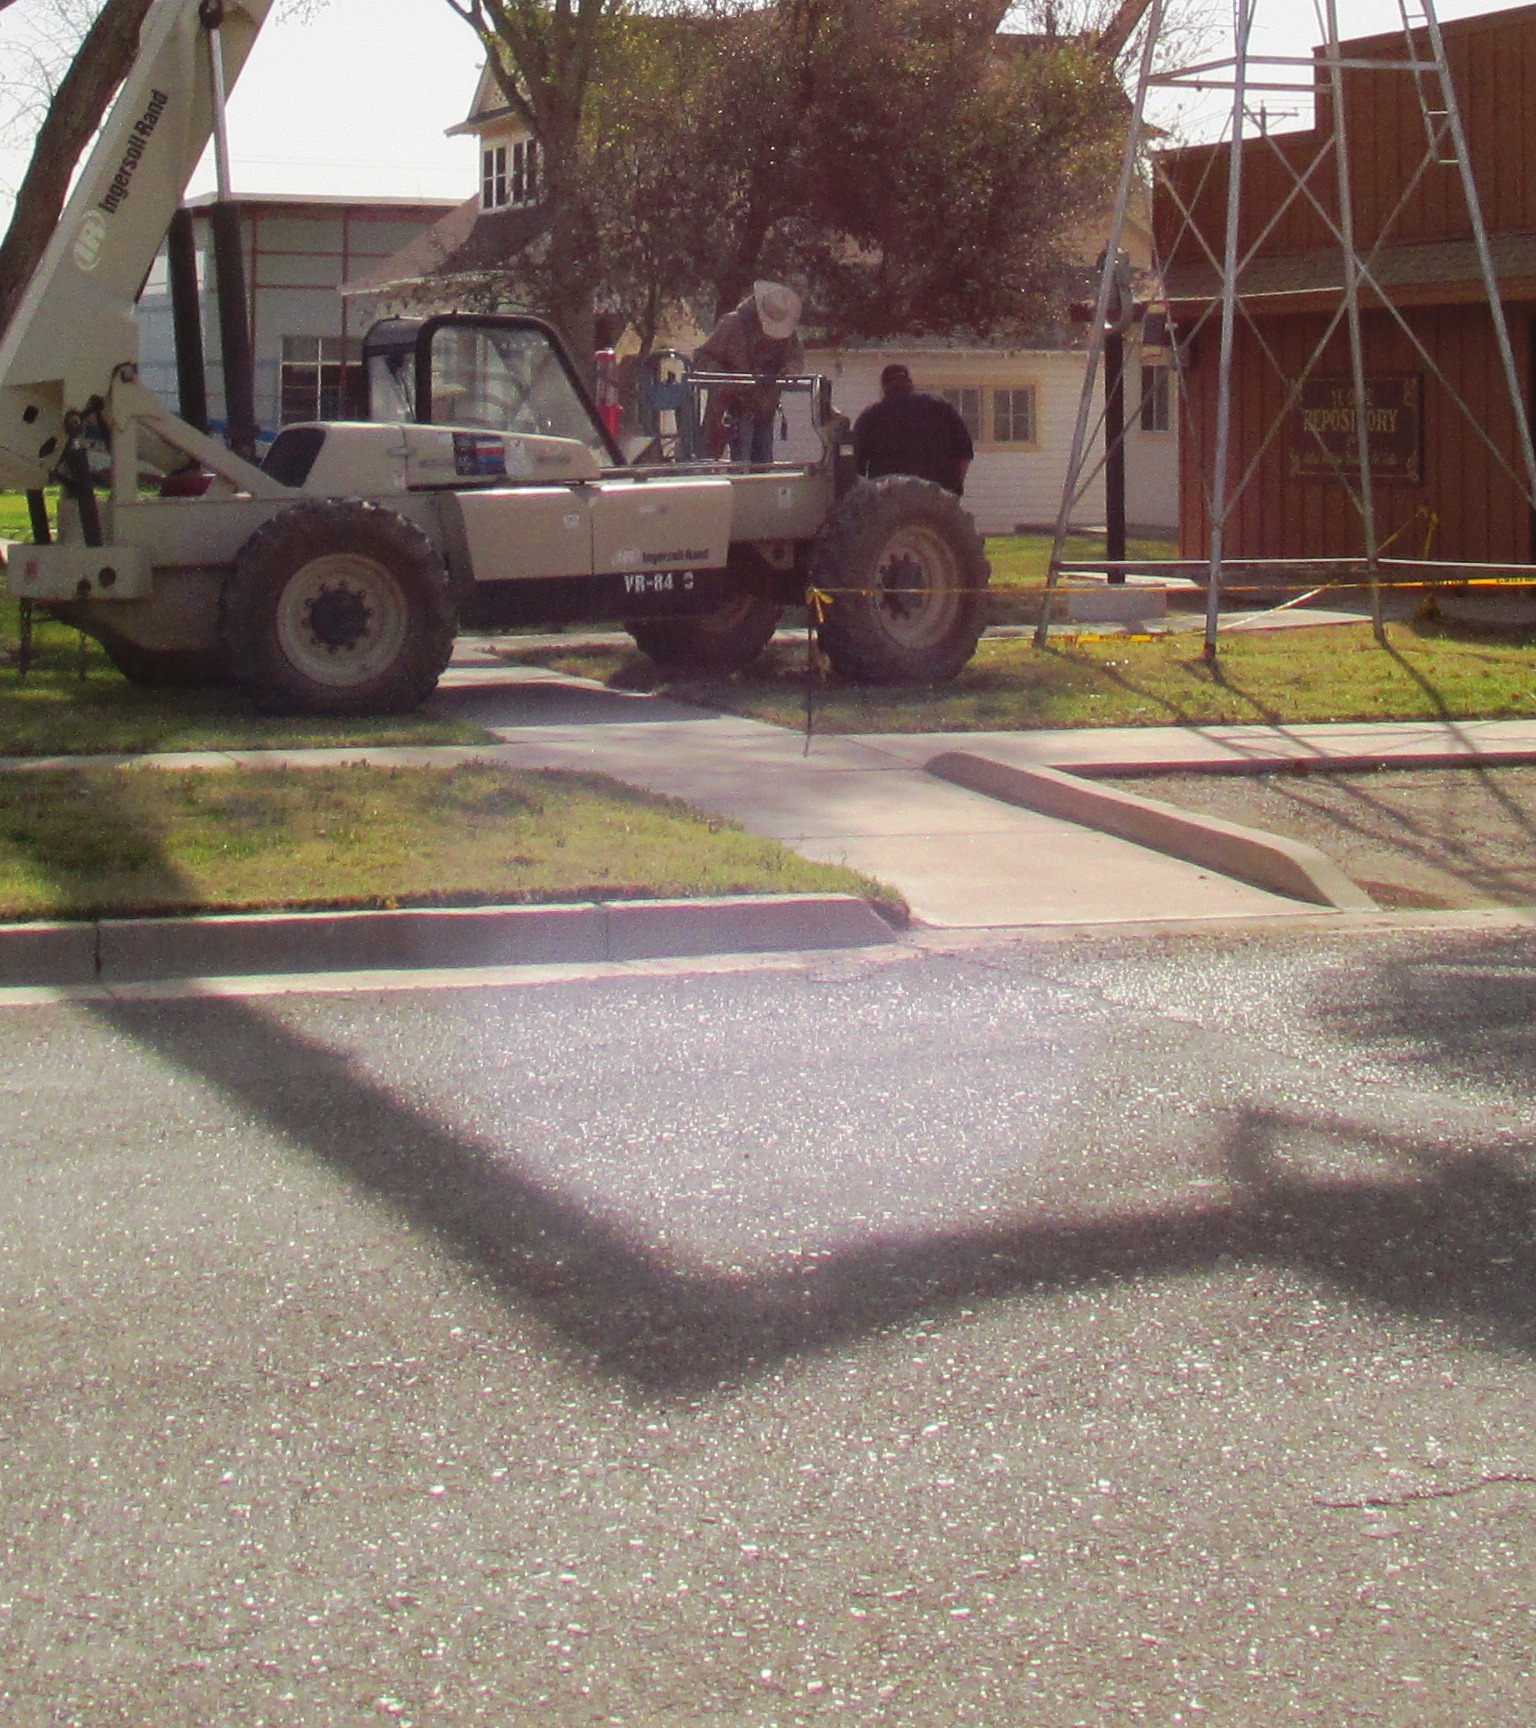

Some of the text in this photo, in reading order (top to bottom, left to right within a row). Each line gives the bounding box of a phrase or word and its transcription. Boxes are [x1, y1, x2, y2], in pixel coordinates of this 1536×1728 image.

[98, 89, 168, 214] Ingersoll Rand
[1303, 408, 1398, 433] REPOSIORY
